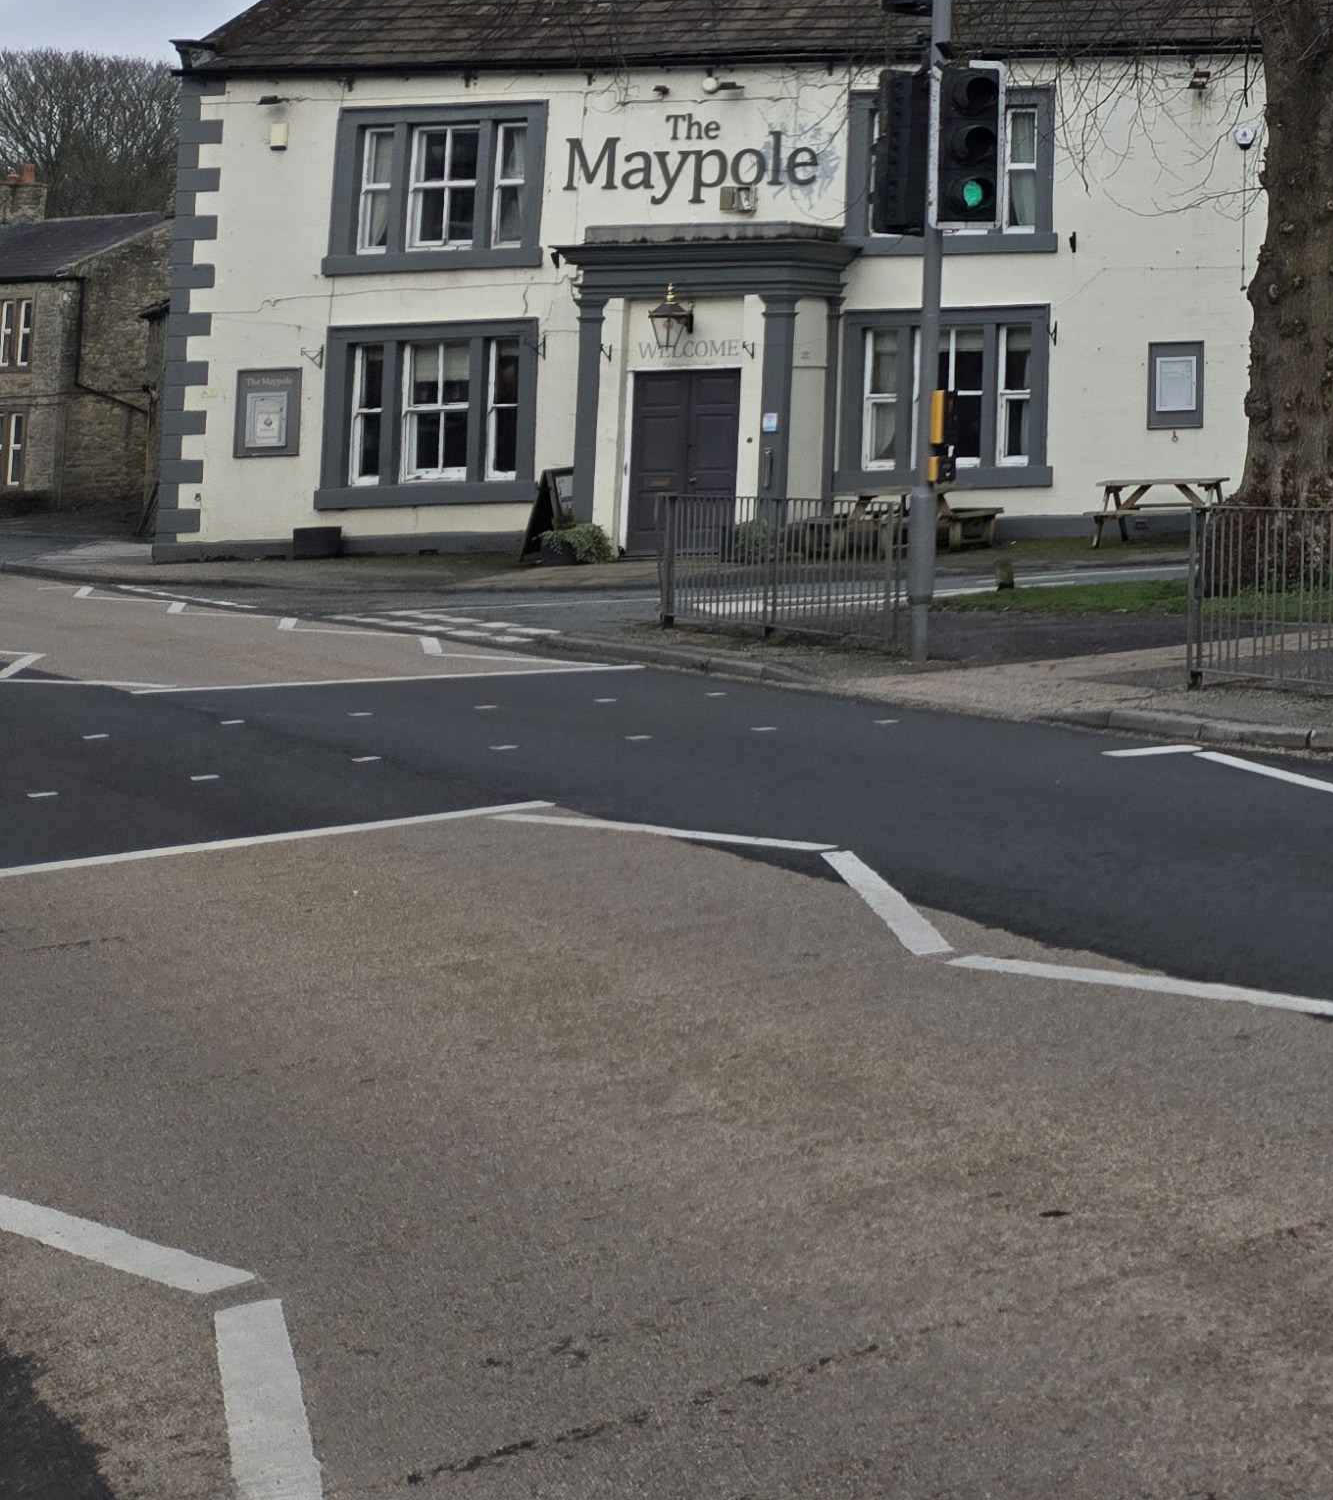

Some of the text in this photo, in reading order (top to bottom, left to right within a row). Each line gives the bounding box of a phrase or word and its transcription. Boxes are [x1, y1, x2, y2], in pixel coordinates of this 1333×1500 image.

[665, 113, 721, 141] The
[562, 130, 819, 205] Maypole
[637, 340, 740, 360] WELCOME
